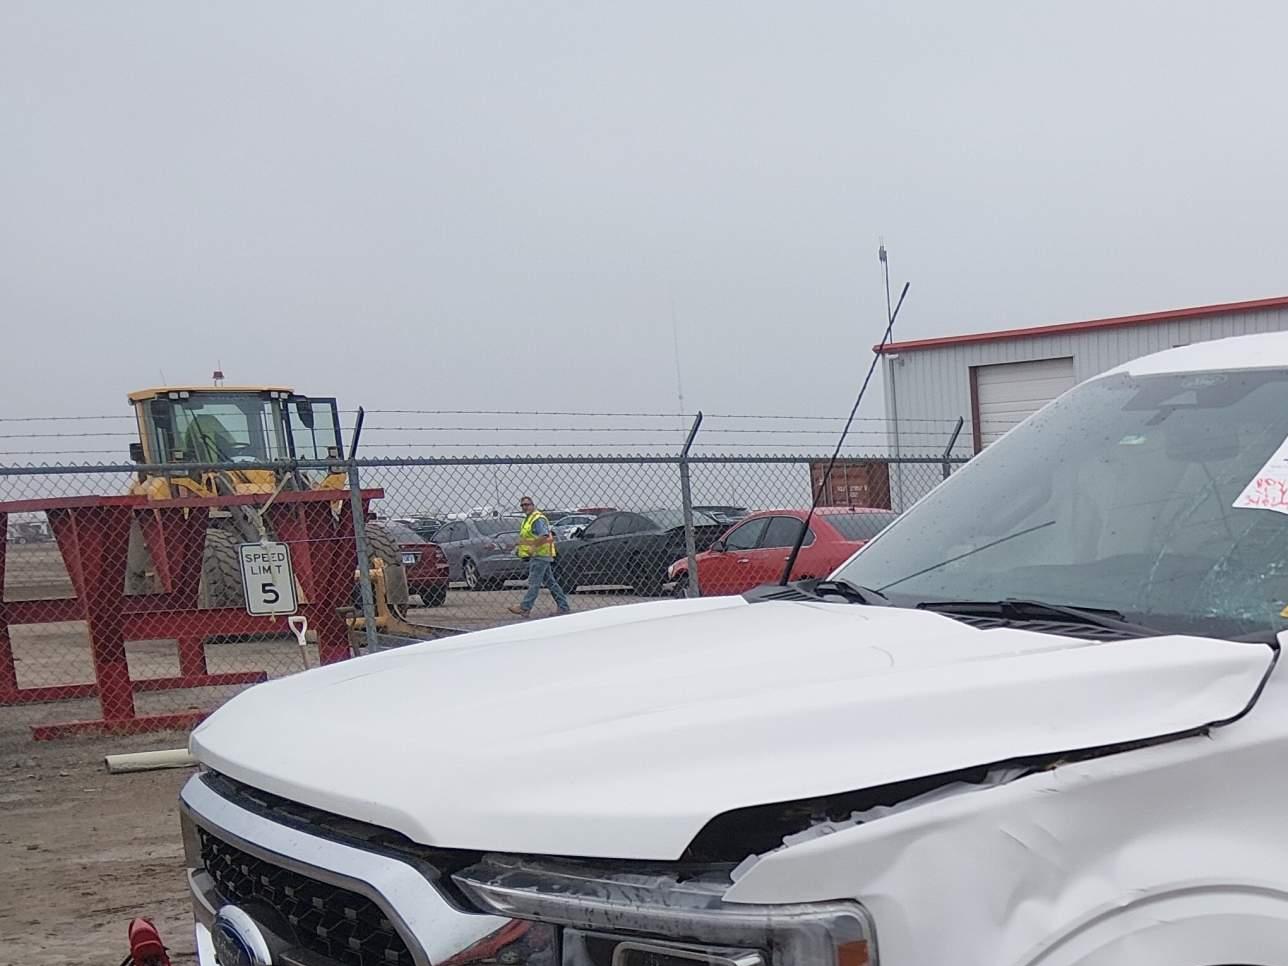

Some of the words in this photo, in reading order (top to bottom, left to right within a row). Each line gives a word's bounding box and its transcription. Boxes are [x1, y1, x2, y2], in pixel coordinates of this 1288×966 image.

[245, 553, 285, 562] SPEED
[251, 565, 282, 575] LIMT
[262, 583, 280, 604] 5
